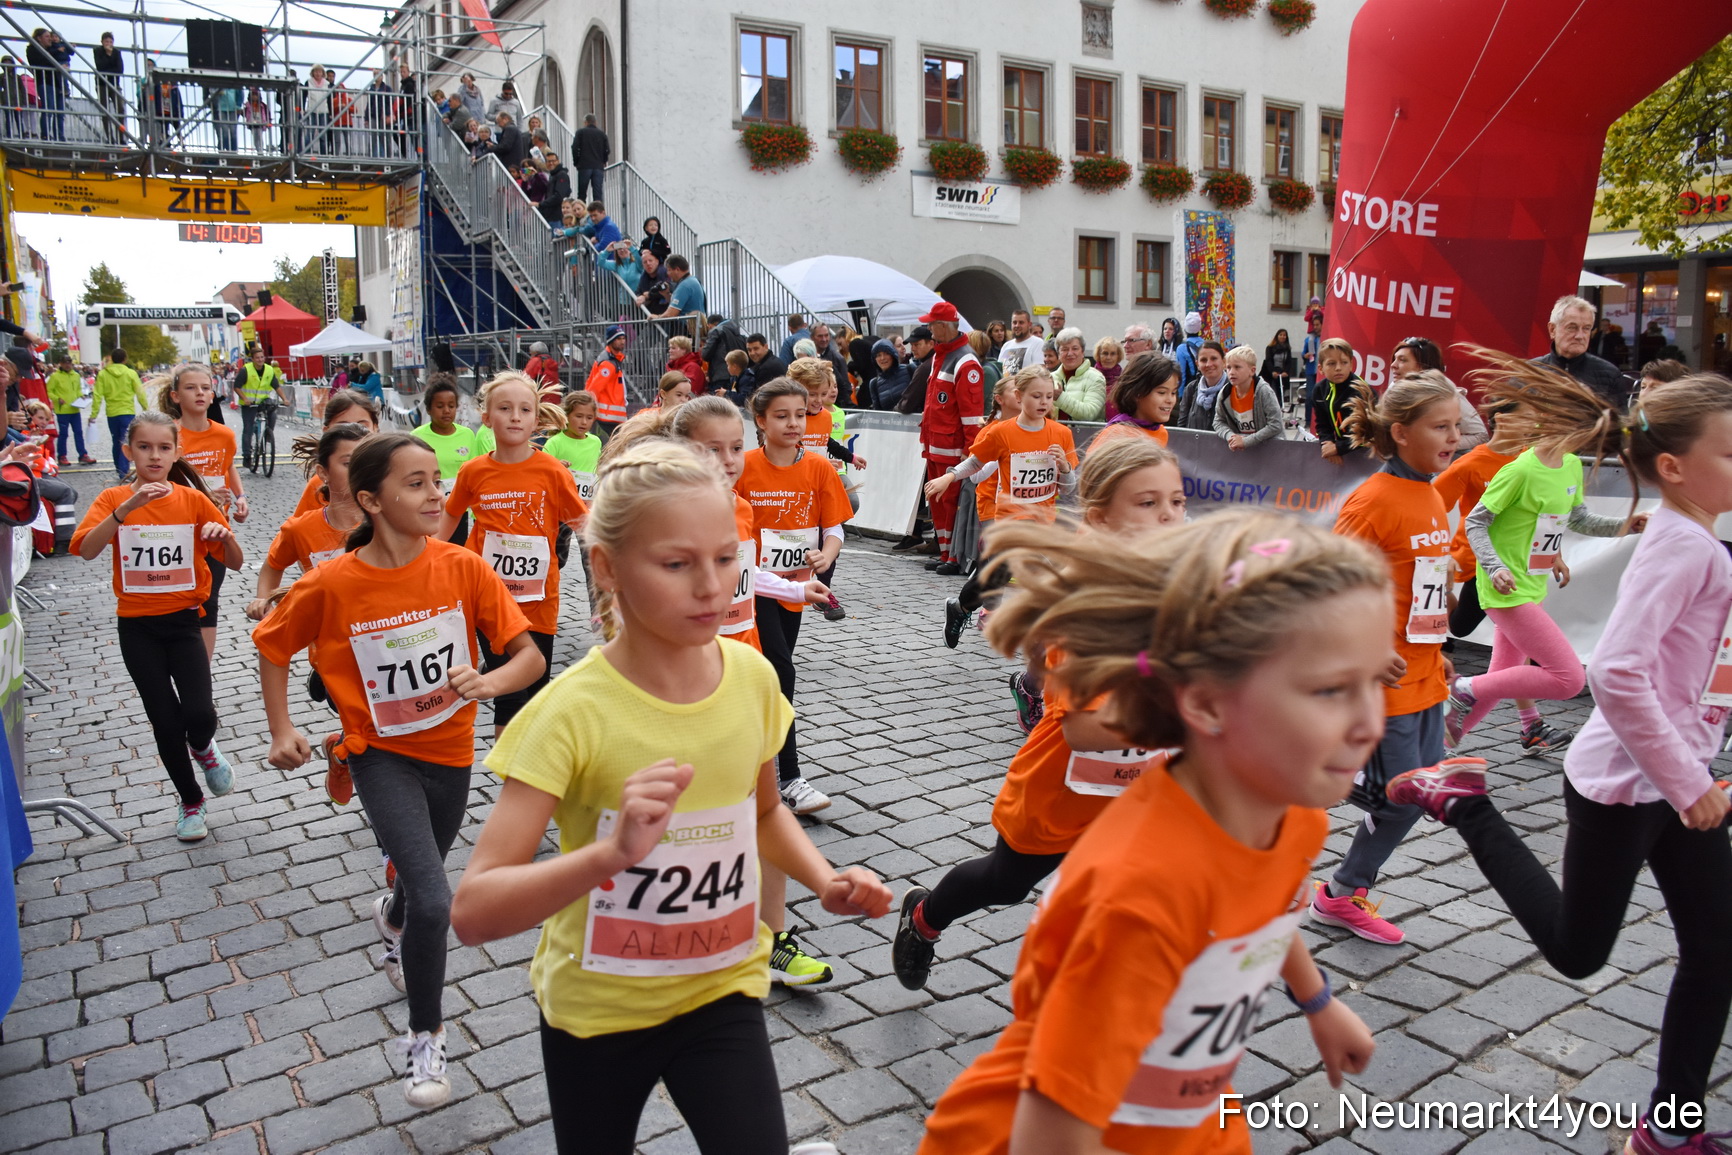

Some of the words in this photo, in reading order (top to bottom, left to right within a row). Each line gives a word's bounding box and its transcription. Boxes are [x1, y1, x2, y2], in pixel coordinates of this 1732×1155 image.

[168, 187, 251, 215] ZIEL
[936, 186, 978, 203] swn
[1340, 190, 1439, 237] STORE
[1333, 266, 1454, 319] ONLINE
[114, 308, 143, 318] MINI
[184, 450, 213, 459] eumarkter
[1019, 467, 1054, 485] 7256
[480, 491, 526, 500] Neumarkter
[576, 483, 594, 498] 199
[750, 490, 796, 498] Neumarkter
[1183, 477, 1270, 505] DUSTRY
[480, 500, 516, 511] Stadtlauf
[750, 498, 787, 508] Stadtlauf
[1410, 530, 1450, 550] ROD
[1541, 532, 1563, 552] 70
[131, 545, 183, 567] 7164
[492, 553, 540, 576] 7033
[147, 573, 170, 582] Selma
[506, 583, 525, 592] ophie
[350, 608, 432, 635] Neumarkter
[398, 628, 438, 647] BOCK
[377, 642, 454, 695] 7167
[415, 696, 444, 713] Sofia
[674, 821, 735, 842] BOCK
[625, 852, 746, 914] 7244
[620, 923, 732, 957] ALINA
